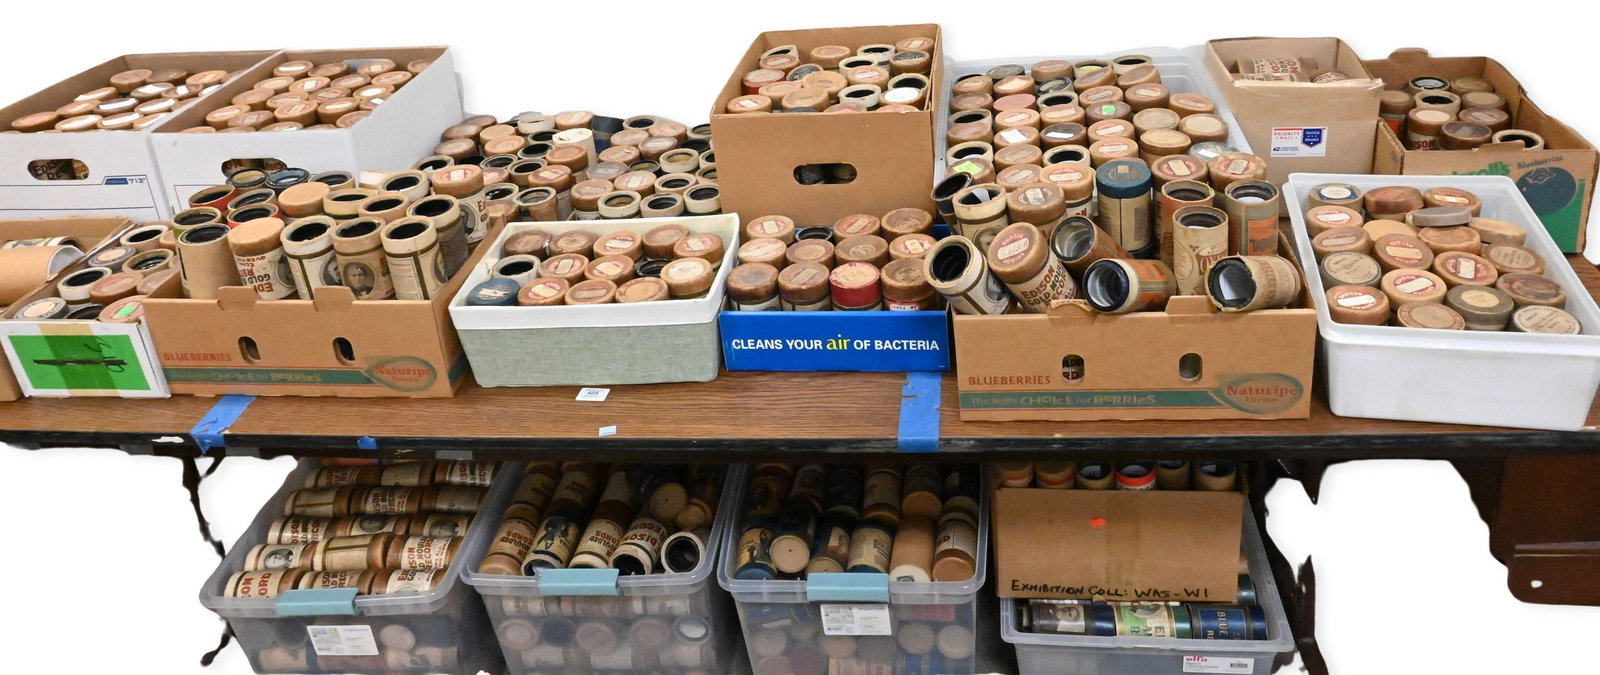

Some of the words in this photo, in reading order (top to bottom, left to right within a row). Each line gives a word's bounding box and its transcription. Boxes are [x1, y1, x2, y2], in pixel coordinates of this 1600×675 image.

[248, 273, 271, 284] GOLD
[1021, 264, 1056, 299] EDISON
[253, 281, 274, 293] EDI
[731, 339, 783, 350] CLEANS
[785, 339, 823, 350] YOUR
[826, 333, 850, 350] air
[853, 339, 871, 350] OF
[874, 339, 940, 351] BACTERIA
[163, 353, 232, 362] BLUEBERRIES
[375, 367, 432, 378] Naturipe
[968, 376, 1051, 386] BLUEBERRIES
[1227, 384, 1298, 398] Naturipe
[622, 533, 658, 547] DISON
[1011, 579, 1084, 595] EXHIBITION
